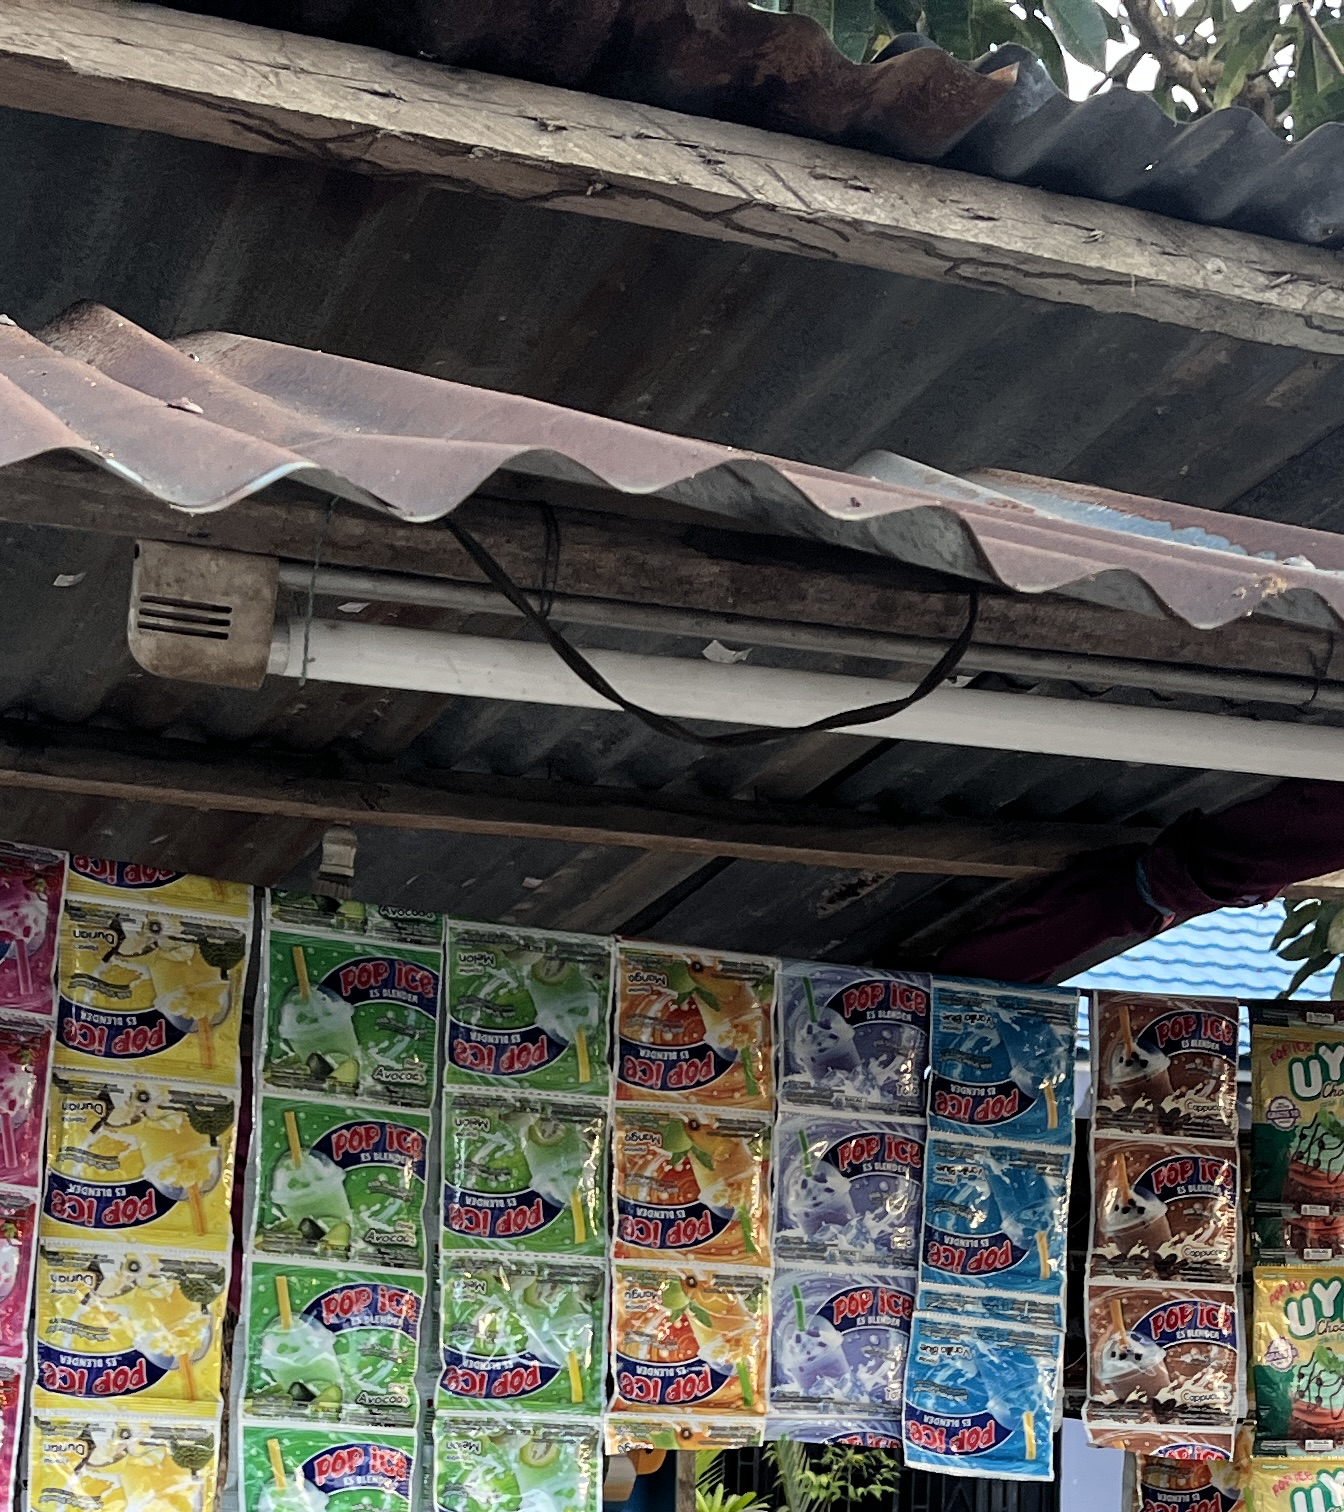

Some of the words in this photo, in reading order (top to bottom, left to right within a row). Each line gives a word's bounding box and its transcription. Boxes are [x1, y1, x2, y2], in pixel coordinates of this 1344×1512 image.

[73, 928, 116, 945] Durian
[457, 953, 496, 967] Melon
[627, 971, 668, 989] Mango
